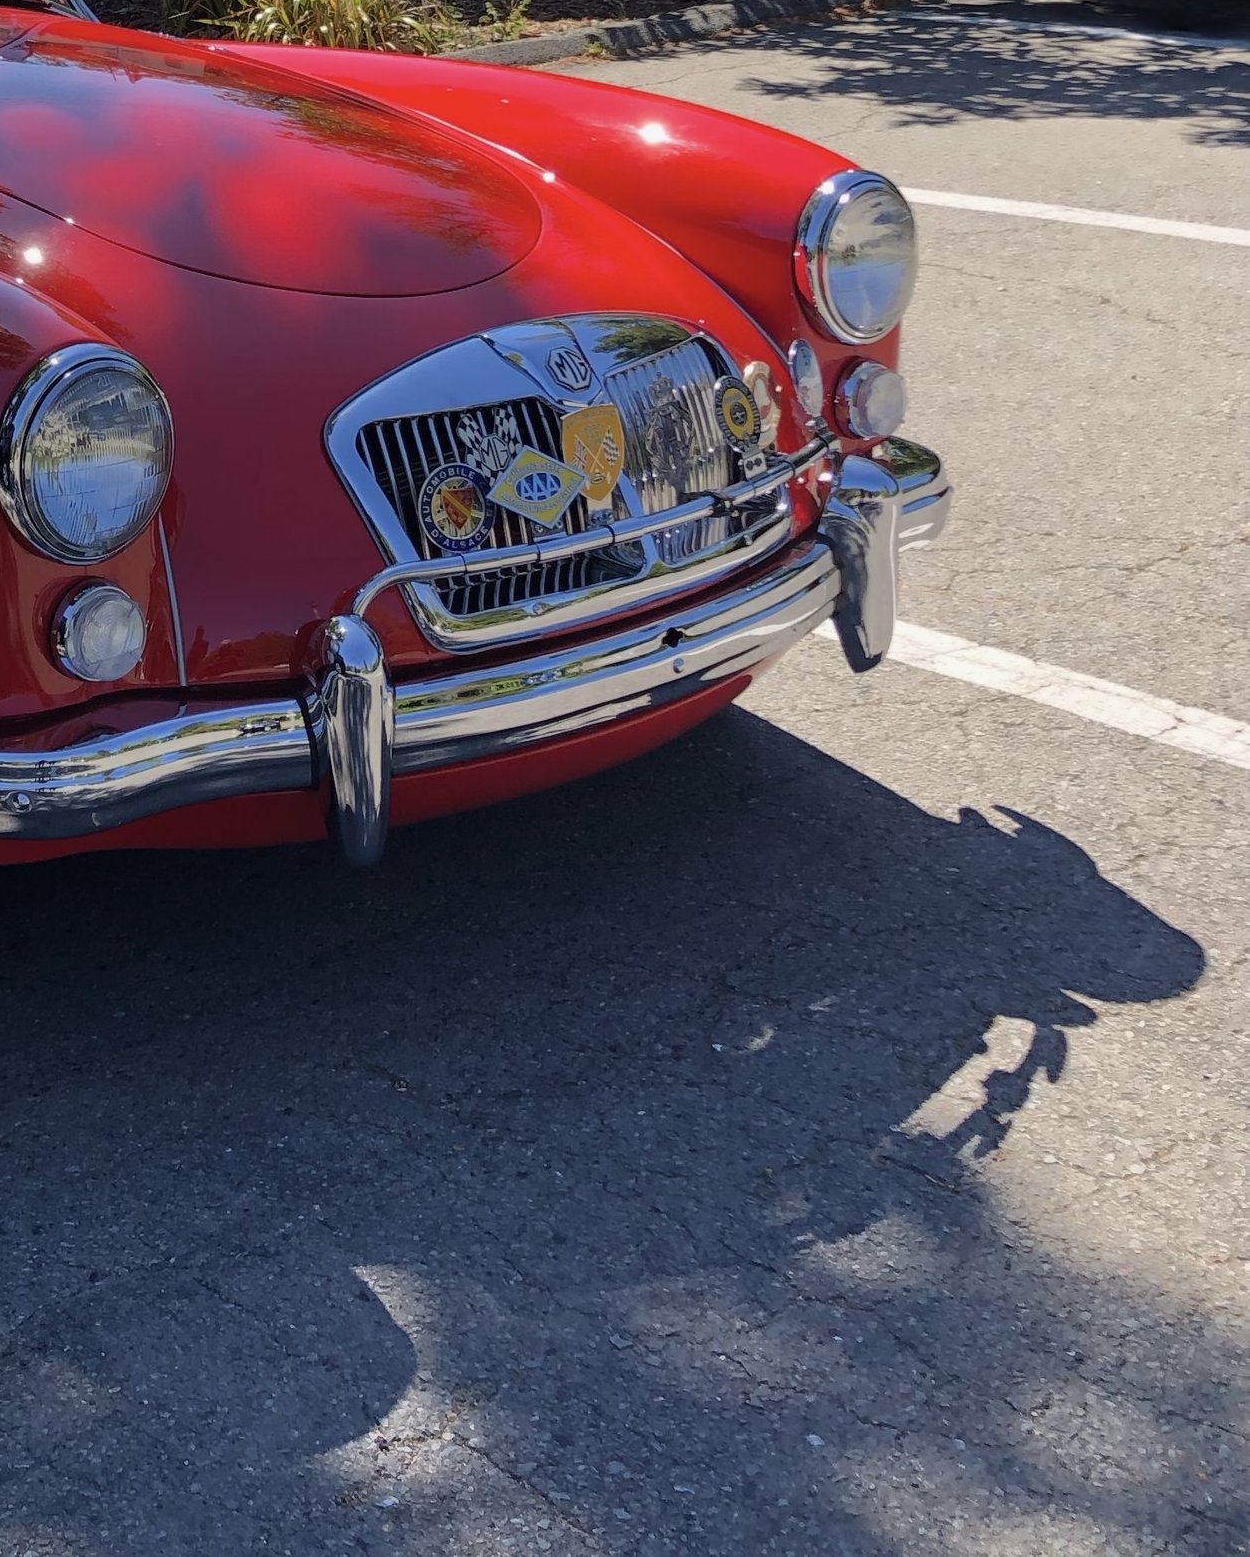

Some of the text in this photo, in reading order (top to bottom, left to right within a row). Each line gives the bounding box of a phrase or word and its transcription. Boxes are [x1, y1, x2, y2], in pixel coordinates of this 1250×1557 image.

[554, 350, 589, 384] MG
[480, 436, 510, 470] MG
[422, 467, 476, 523] AUTOMOBILE
[520, 473, 559, 501] AAA
[430, 525, 489, 549] D'ALSACE
